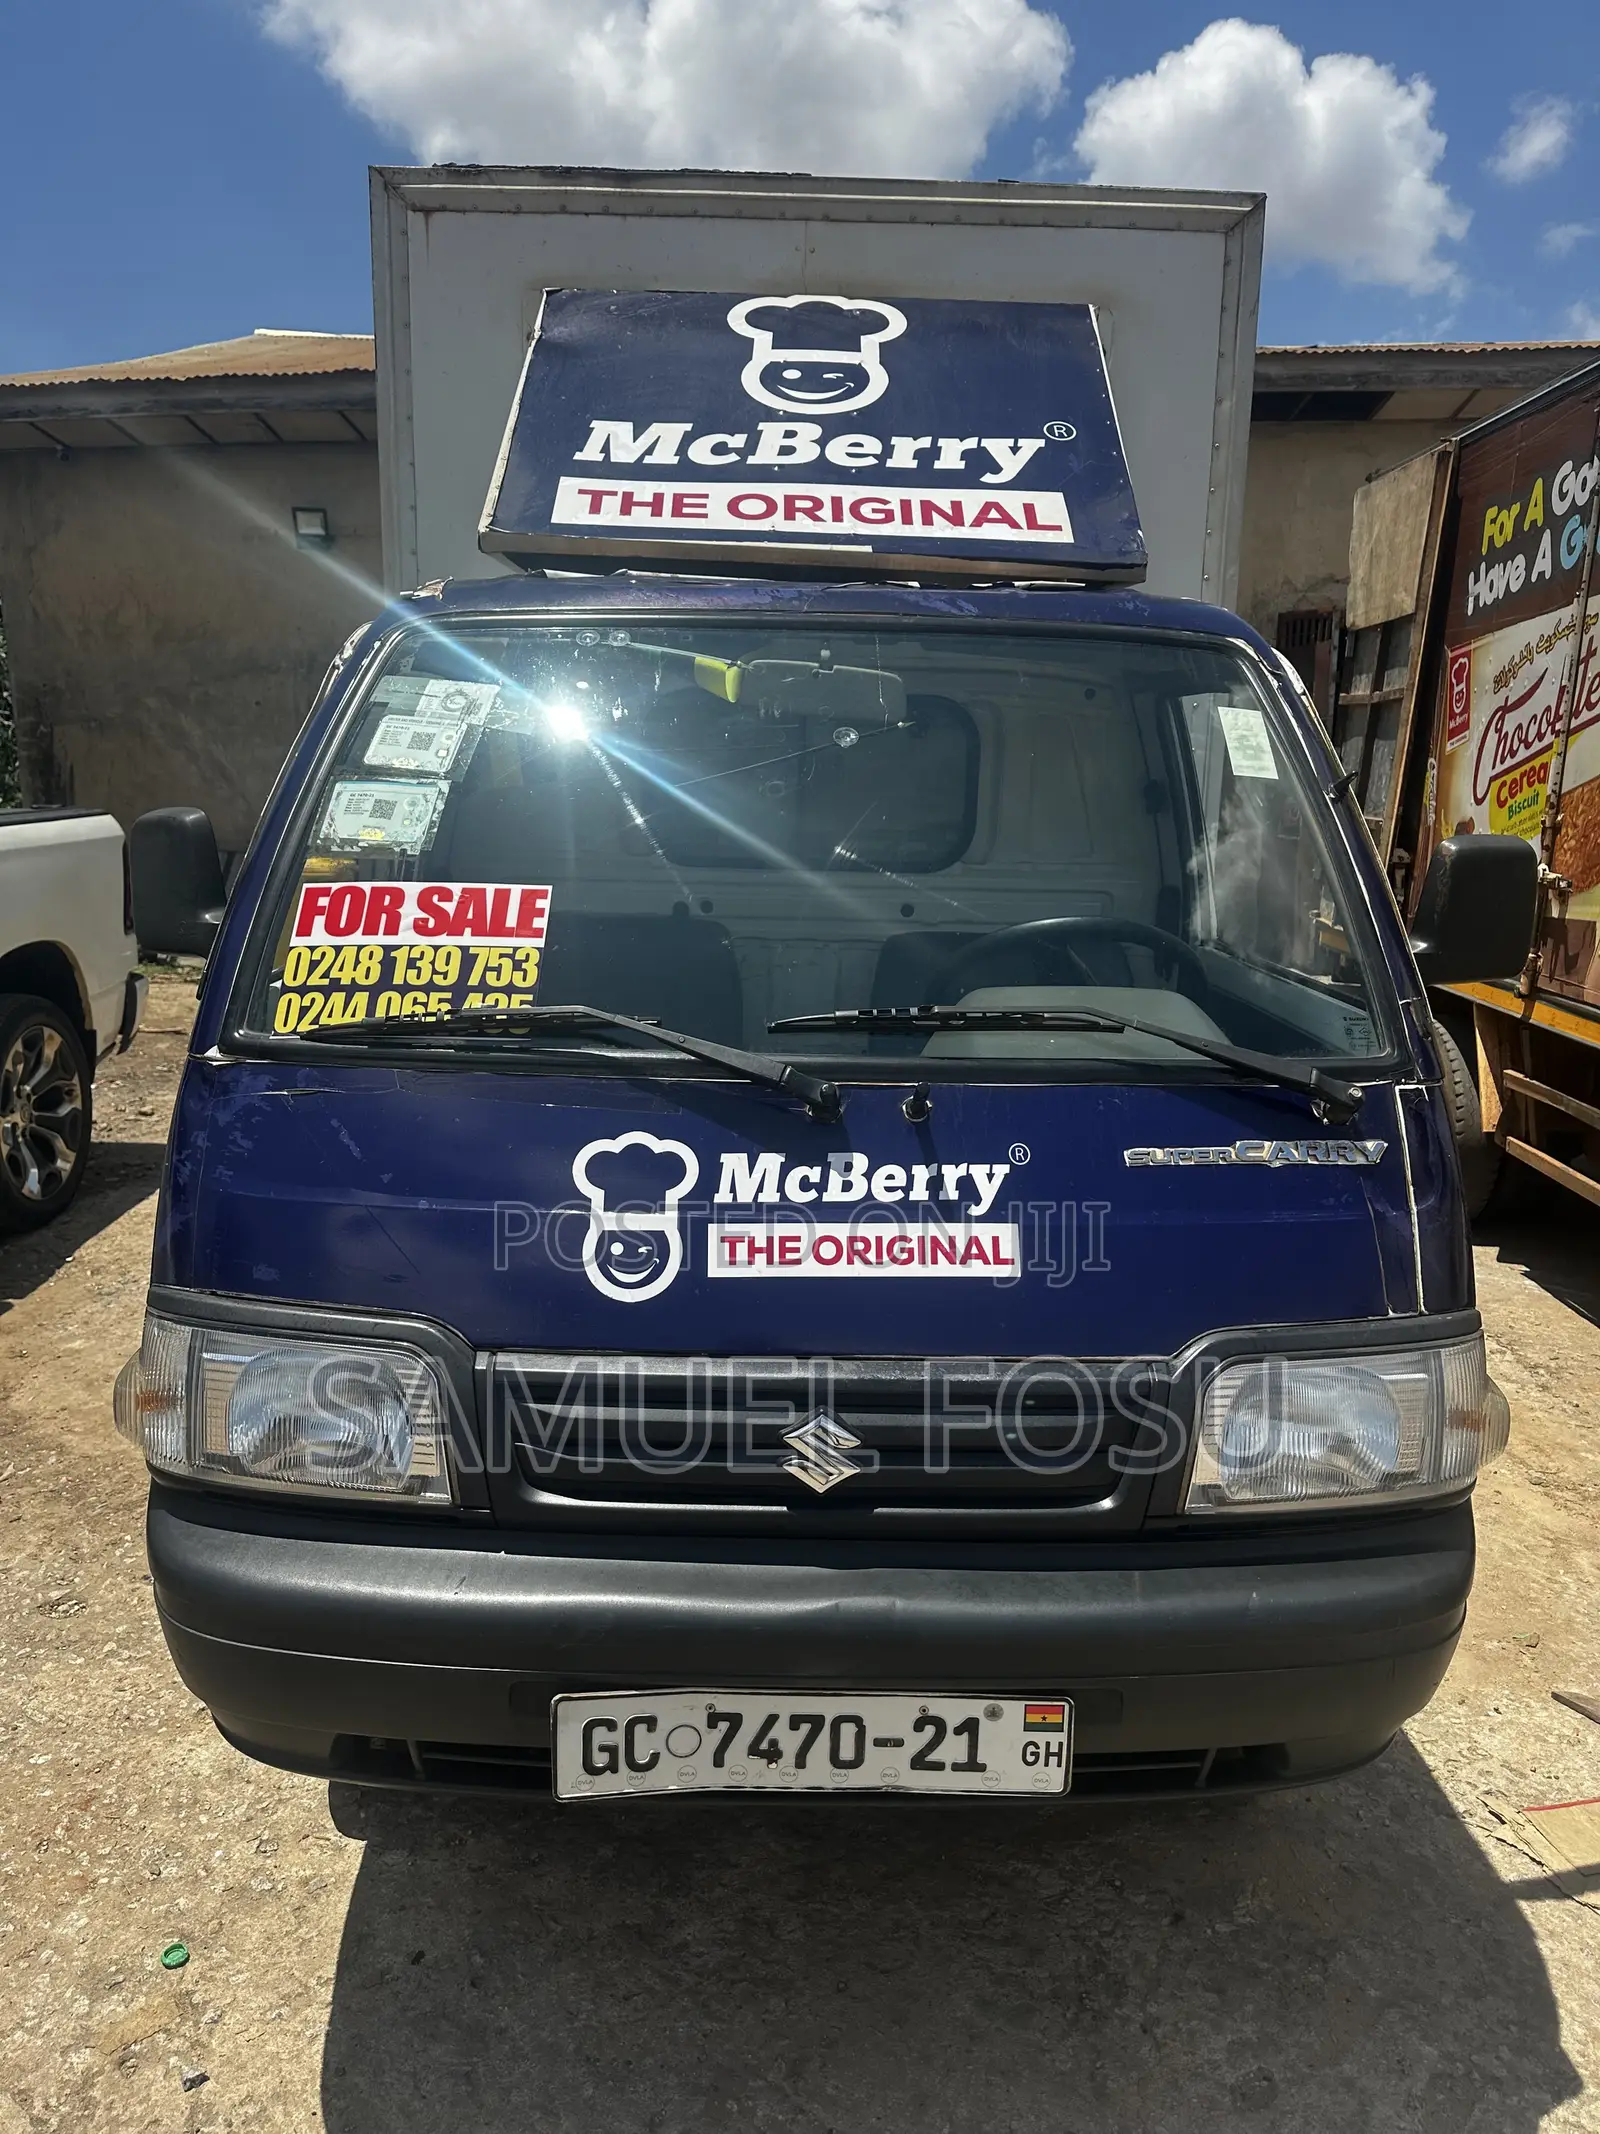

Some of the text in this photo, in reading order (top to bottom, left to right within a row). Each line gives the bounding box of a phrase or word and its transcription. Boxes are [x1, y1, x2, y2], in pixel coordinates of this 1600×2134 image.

[577, 488, 1064, 533] THE ORIGINAL
[1482, 504, 1520, 556] For
[1523, 477, 1544, 532] A
[1466, 553, 1526, 616] Have
[1531, 529, 1552, 583] A
[1496, 761, 1549, 808] Cerea
[1507, 789, 1540, 820] Biscuit
[295, 885, 549, 939] FOR SALE
[283, 944, 541, 988] 0248 139 753
[720, 1234, 1015, 1267] THE ORIGINAL
[581, 1711, 987, 1776] GC 7470-21
[1021, 1740, 1064, 1768] GH
